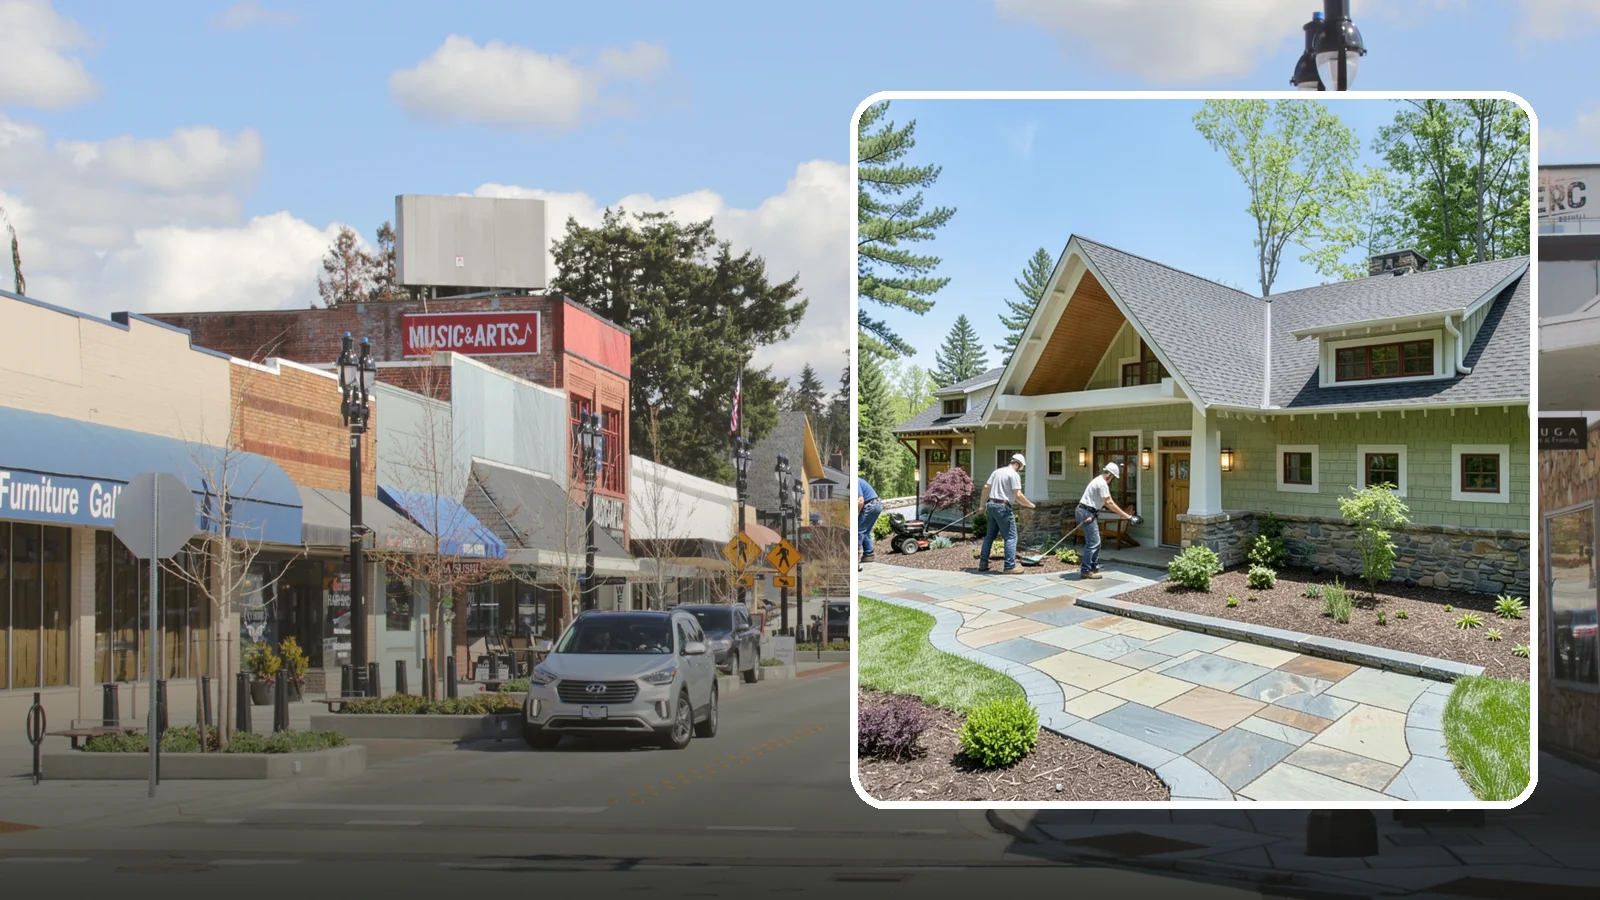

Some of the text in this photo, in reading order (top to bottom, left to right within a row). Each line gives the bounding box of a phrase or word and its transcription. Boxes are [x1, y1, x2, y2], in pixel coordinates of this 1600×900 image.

[408, 322, 519, 348] MUSIC&ARTS
[1552, 436, 1579, 444] Framing
[0, 472, 121, 519] Furniture Gal
[453, 563, 479, 574] SUSHI
